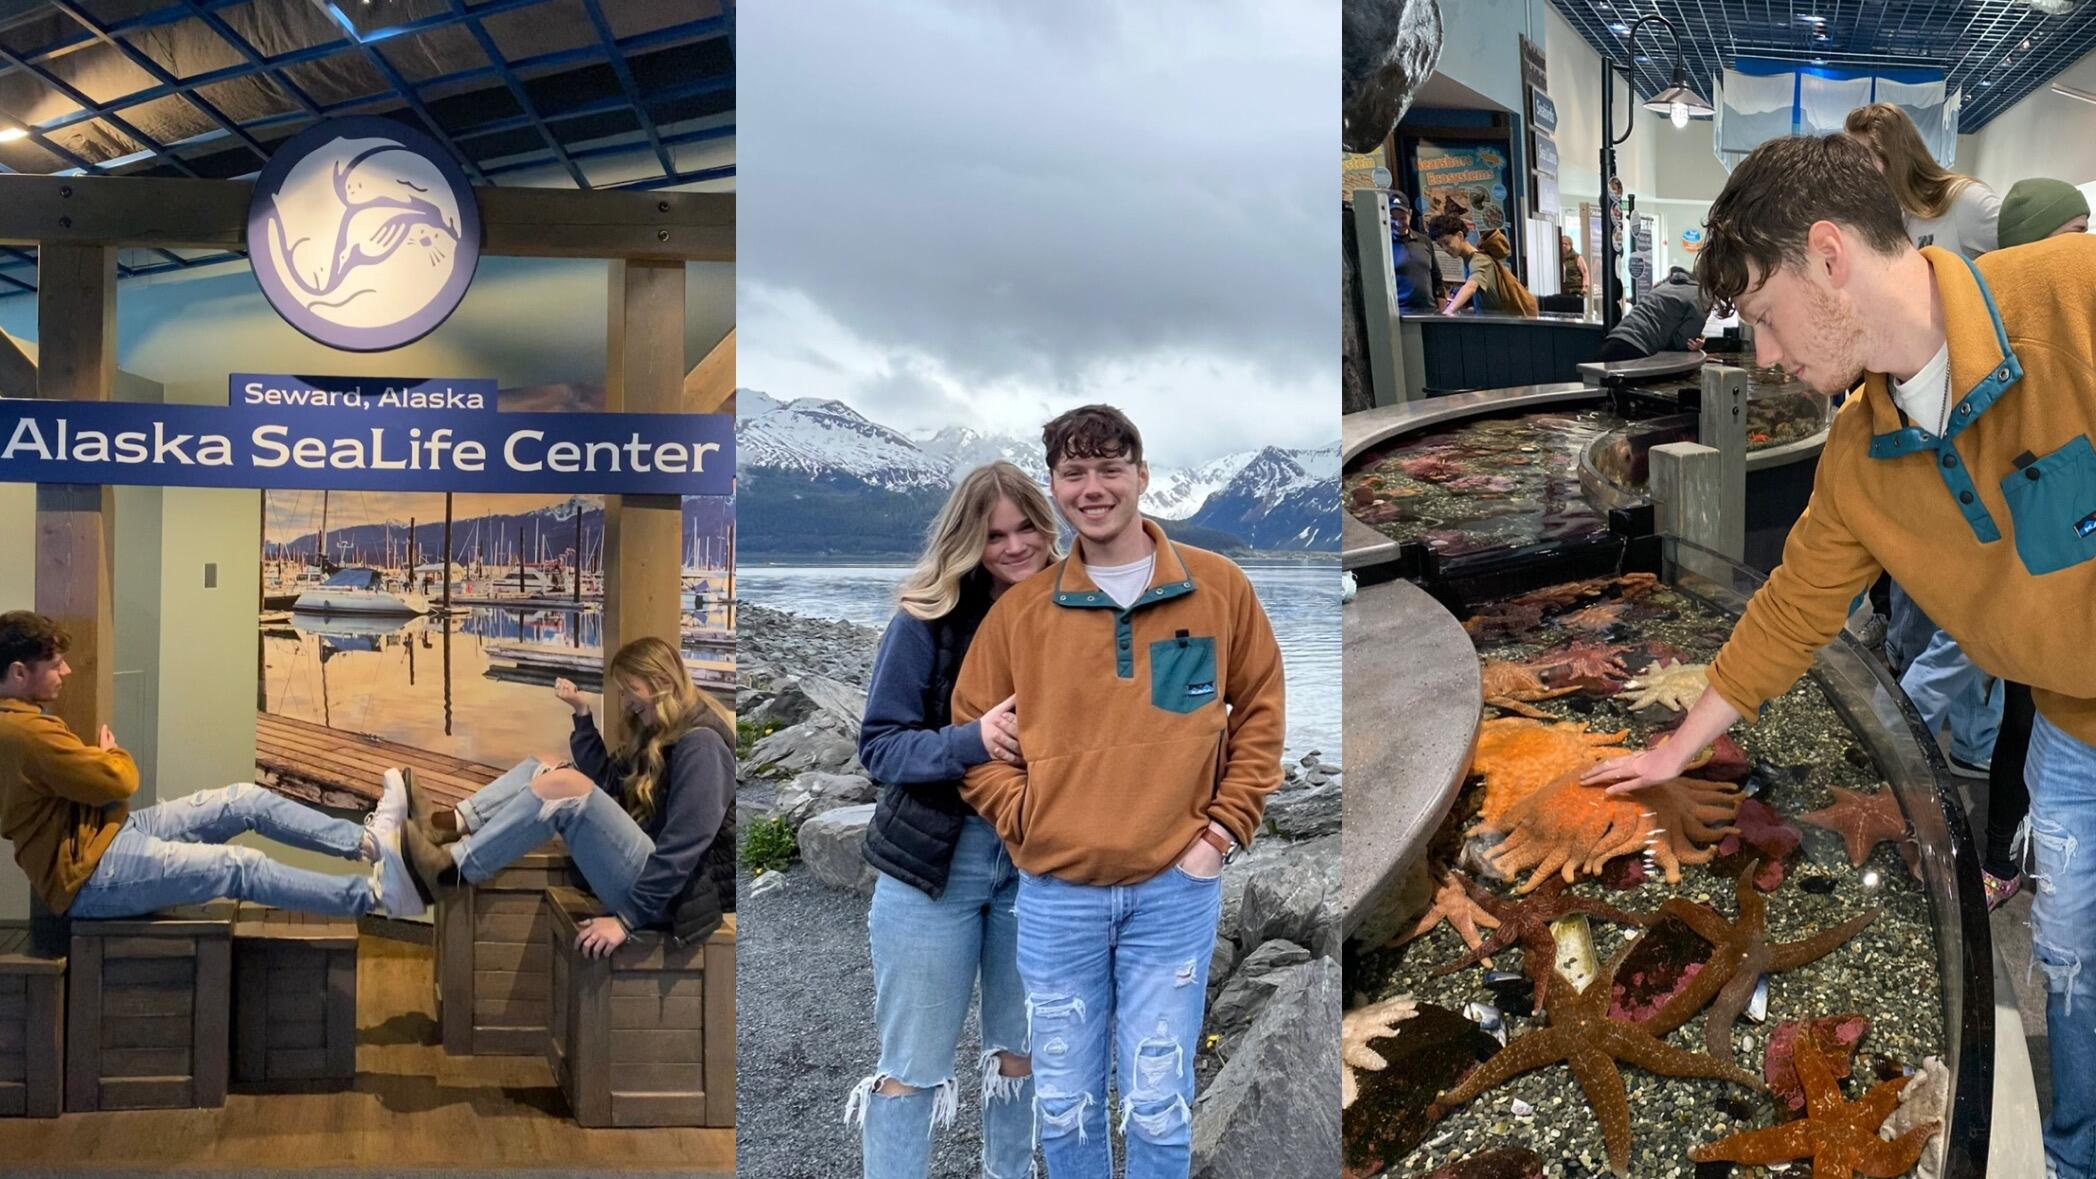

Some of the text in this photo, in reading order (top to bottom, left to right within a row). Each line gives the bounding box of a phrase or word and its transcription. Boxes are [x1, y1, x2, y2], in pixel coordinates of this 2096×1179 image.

[244, 382, 484, 411] Seward, Alaska
[1, 418, 721, 474] Alaska SeaLife Center
